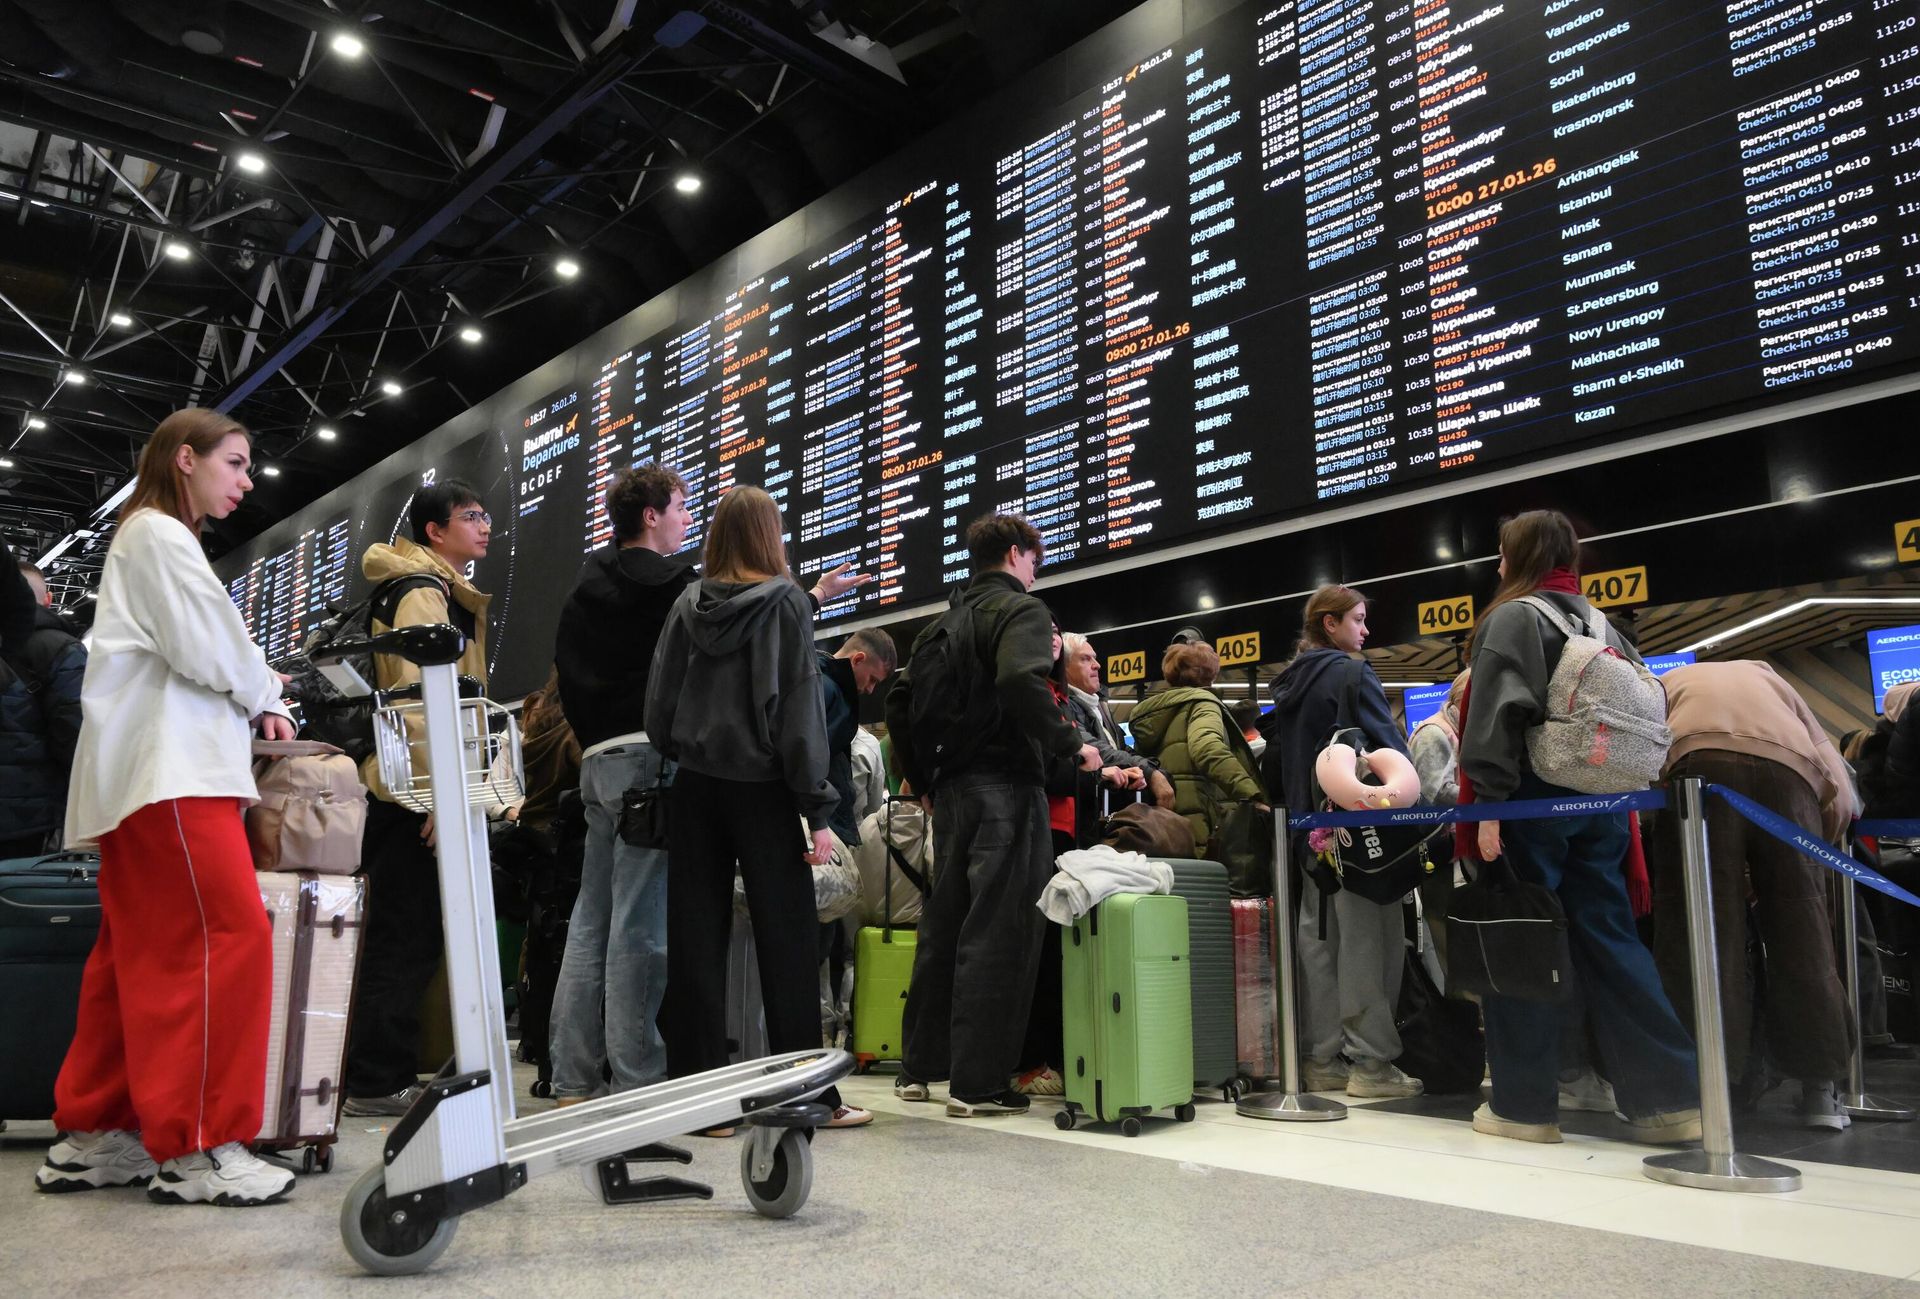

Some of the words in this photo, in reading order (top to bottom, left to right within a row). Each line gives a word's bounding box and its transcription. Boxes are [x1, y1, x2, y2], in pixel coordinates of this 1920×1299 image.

[1386, 26, 1411, 44] 09:30
[1545, 7, 1604, 39] Varadero
[1876, 16, 1915, 39] 11:20
[1547, 21, 1630, 63] Cherepovets
[1731, 31, 1806, 67] Регистрация
[1808, 27, 1816, 36] в
[1818, 11, 1852, 31] 03:55
[1416, 42, 1472, 76] Абу-Даби
[1732, 53, 1780, 76] Check-in
[1783, 37, 1816, 57] 03:55
[1880, 45, 1918, 67] 11:25
[1102, 76, 1122, 93] 18:37
[1139, 48, 1172, 73] 26.01.26
[1388, 71, 1413, 88] 09:35
[1418, 65, 1477, 98] Варадеро
[1549, 65, 1584, 89] Sochi
[1389, 94, 1415, 111] 09:40
[1551, 71, 1635, 113] Ekaterinburg
[1736, 87, 1812, 121] Регистрация
[1814, 84, 1822, 92] в
[1824, 68, 1860, 88] 04:00
[1553, 98, 1634, 138] Krasnoyarsk
[1738, 109, 1786, 131] Check-in
[1789, 94, 1822, 112] 04:00
[1420, 124, 1450, 143] Сочи
[1422, 125, 1505, 167] Екатеринбург
[1742, 144, 1818, 176] Регистрация
[1820, 141, 1829, 149] в
[1831, 126, 1866, 145] 08:05
[1393, 162, 1418, 179] 09:45
[1423, 155, 1495, 191] Красноярск
[1556, 150, 1639, 189] Arkhangelsk
[1743, 165, 1792, 186] Check-in
[1795, 151, 1828, 169] 08:05
[1394, 185, 1420, 202] 09:55
[1426, 190, 1473, 219] 10:00
[1478, 158, 1556, 199] 27.01.26
[1559, 185, 1612, 214] Istanbul
[1426, 201, 1502, 238] Архангельск
[1561, 217, 1600, 239] Minsk
[1397, 233, 1422, 248] 10:00
[1427, 235, 1478, 261] Стамбул
[1562, 241, 1612, 265] Samara
[1364, 270, 1387, 284] 03:00
[1399, 256, 1423, 272] 10:05
[1429, 264, 1468, 285] Минск
[1565, 259, 1635, 291] Murmansk
[1754, 260, 1831, 289] Регистрация
[1834, 257, 1842, 266] в
[1844, 244, 1880, 262] 07:35
[1357, 282, 1379, 296] 03:00
[1430, 286, 1477, 309] Самара
[1755, 280, 1805, 300] Check-in
[1807, 268, 1842, 285] 07:35
[1401, 304, 1426, 319] 10:10
[1566, 281, 1658, 317] St.Petersburg
[1432, 305, 1495, 334] Мурманск
[1568, 325, 1602, 343] Novy
[1606, 307, 1665, 332] Urengoy
[1105, 342, 1137, 362] 09:00
[1140, 322, 1190, 349] 27.01.26
[1402, 328, 1427, 343] 10:25
[1433, 317, 1540, 358] Санкт-Петербург
[741, 345, 768, 368] 27.01.26
[1404, 352, 1429, 367] 10:30
[1434, 360, 1475, 383] Новый
[1476, 344, 1531, 370] Уренгой
[1571, 337, 1660, 369] Makhachkala
[1762, 350, 1841, 376] Регистрация
[1844, 347, 1853, 356] в
[1854, 336, 1892, 353] 04:40
[740, 374, 767, 397] 27.01.26
[1572, 377, 1615, 396] Sharm
[1618, 357, 1684, 384] el-Sheikh
[1764, 369, 1814, 387] Check-in
[1817, 358, 1852, 374] 04:40
[1436, 380, 1504, 407] Махачкала
[530, 408, 548, 426] 18:37
[1406, 401, 1431, 415] 10:35
[1436, 403, 1471, 417] SU1054
[1437, 411, 1477, 435] Шарм
[1478, 404, 1501, 424] Эль
[1502, 396, 1540, 415] Шейх
[1574, 405, 1615, 423] Kazan
[522, 423, 563, 456] Вылеты
[737, 435, 765, 456] 27.01.26
[1438, 430, 1467, 442] SU430
[1438, 439, 1482, 457] Казань
[522, 432, 579, 472] Departures
[881, 463, 905, 479] 08:00
[906, 451, 942, 471] 27.01.26
[1409, 451, 1434, 465] 10:40
[1439, 453, 1474, 468] SU1190
[520, 481, 527, 495] B
[528, 477, 535, 491] C
[537, 473, 545, 487] D
[546, 468, 553, 483] E
[555, 464, 562, 479] F
[1586, 572, 1642, 602] 407
[1422, 602, 1470, 628] 406
[1218, 636, 1258, 660] 405
[1110, 656, 1144, 678] 404
[1652, 660, 1688, 670] ROSSIYA
[1408, 690, 1442, 700] AEROFLOT
[1390, 812, 1438, 822] AEROFLOT
[1552, 800, 1610, 812] AEROFLOT
[1792, 834, 1864, 878] AEROFLOT
